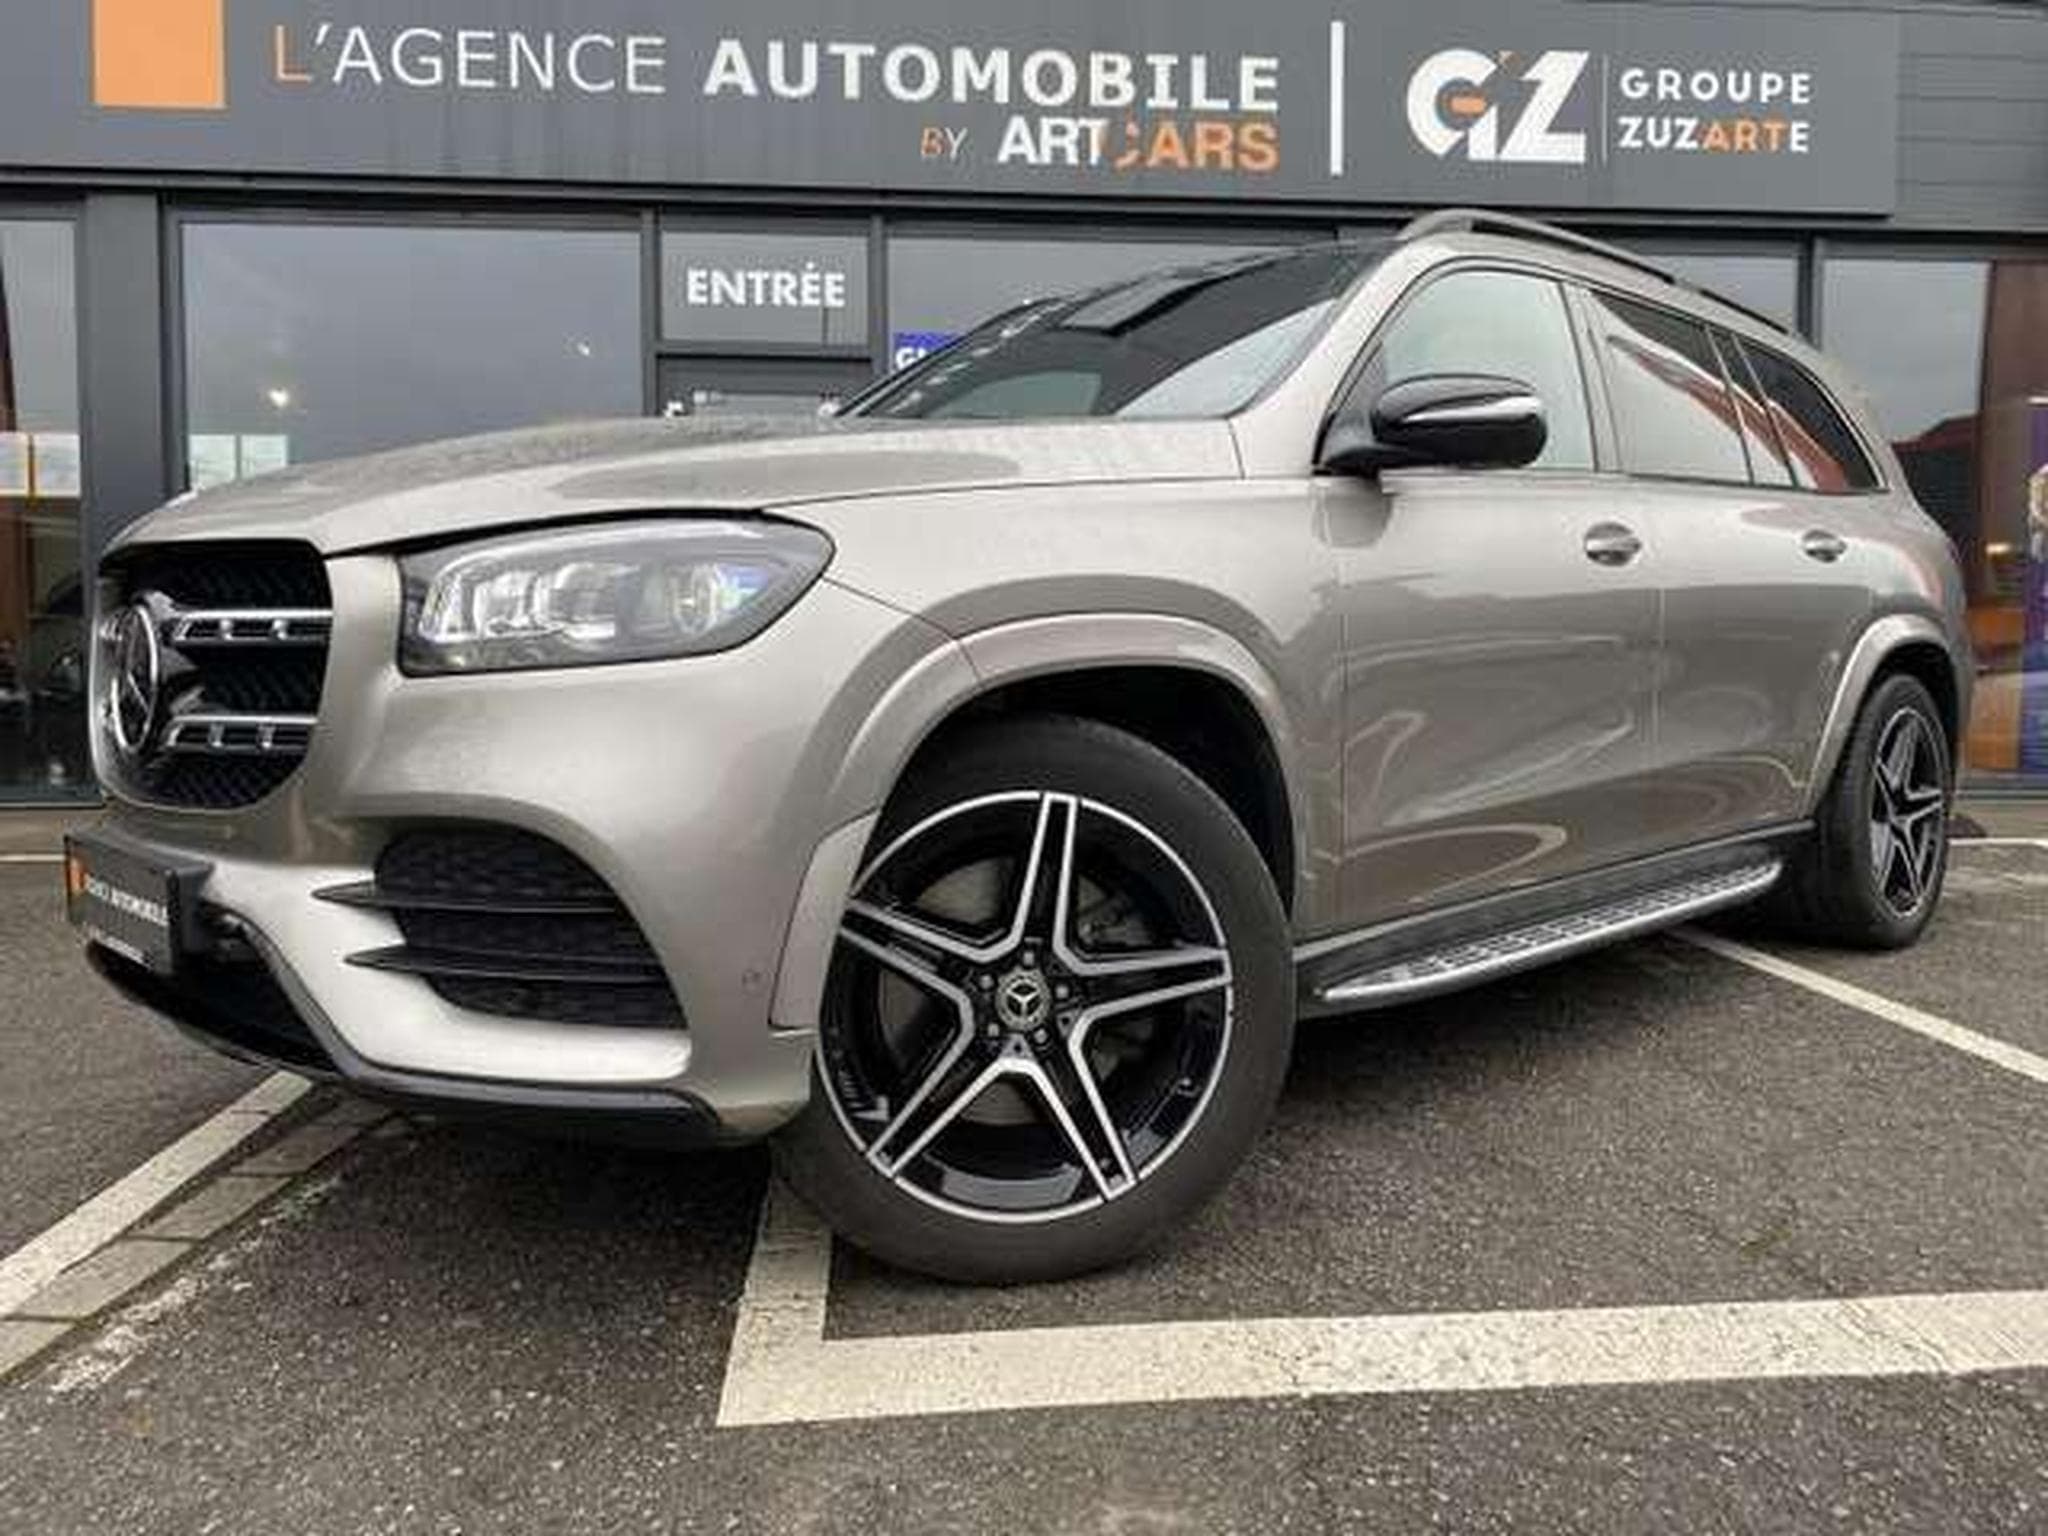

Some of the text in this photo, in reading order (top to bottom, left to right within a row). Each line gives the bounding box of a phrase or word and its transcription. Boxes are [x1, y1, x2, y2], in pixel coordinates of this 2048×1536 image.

[275, 23, 1280, 112] L'AGENCE AUTOMOBILE
[1619, 67, 1812, 104] GROUPE
[920, 126, 968, 160] BY
[1617, 115, 1811, 152] ZUZARTE
[686, 261, 847, 308] ENTRÉE
